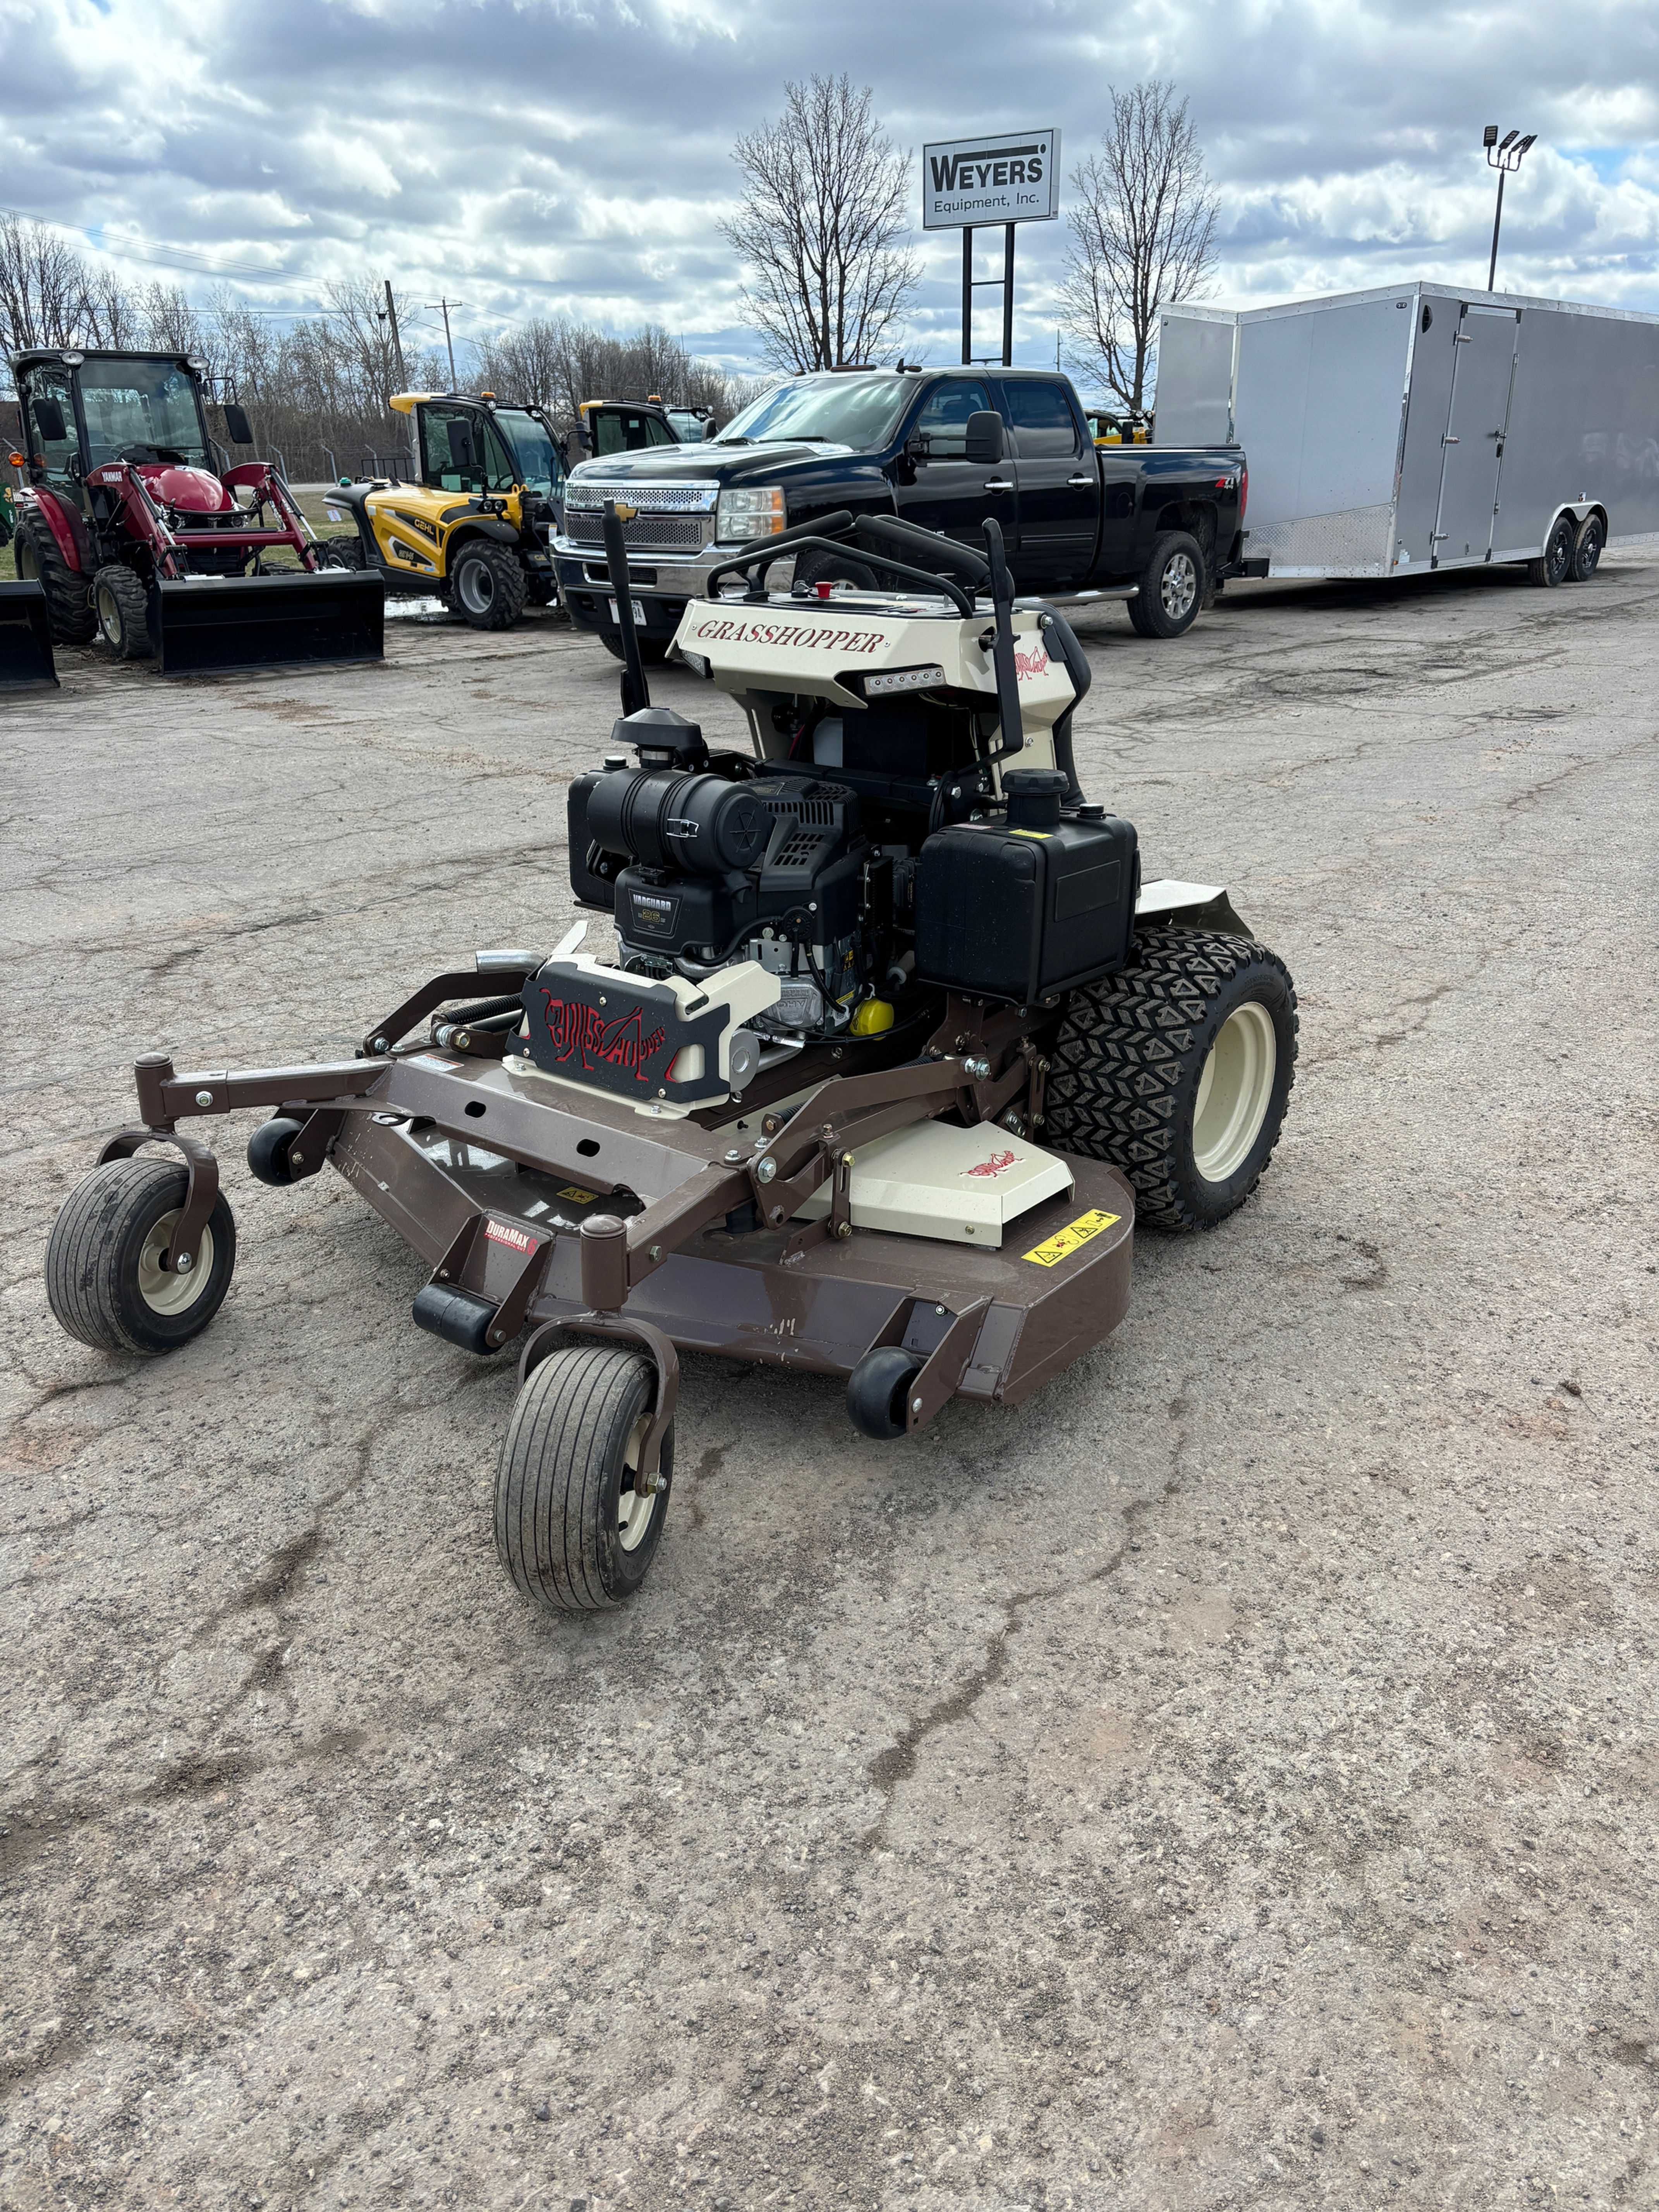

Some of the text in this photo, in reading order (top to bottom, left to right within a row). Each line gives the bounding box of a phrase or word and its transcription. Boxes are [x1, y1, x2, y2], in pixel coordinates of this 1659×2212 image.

[930, 155, 1042, 192] WEYERS
[934, 192, 1039, 213] Equipment, Inc.
[101, 471, 122, 482] YANMAR
[1215, 477, 1234, 488] Z71
[415, 519, 434, 535] GEHL
[697, 620, 885, 653] GRASSHOPPER
[633, 894, 671, 912] VANGUARD
[642, 908, 660, 922] 26
[486, 1220, 537, 1256] DURAMAX 6
